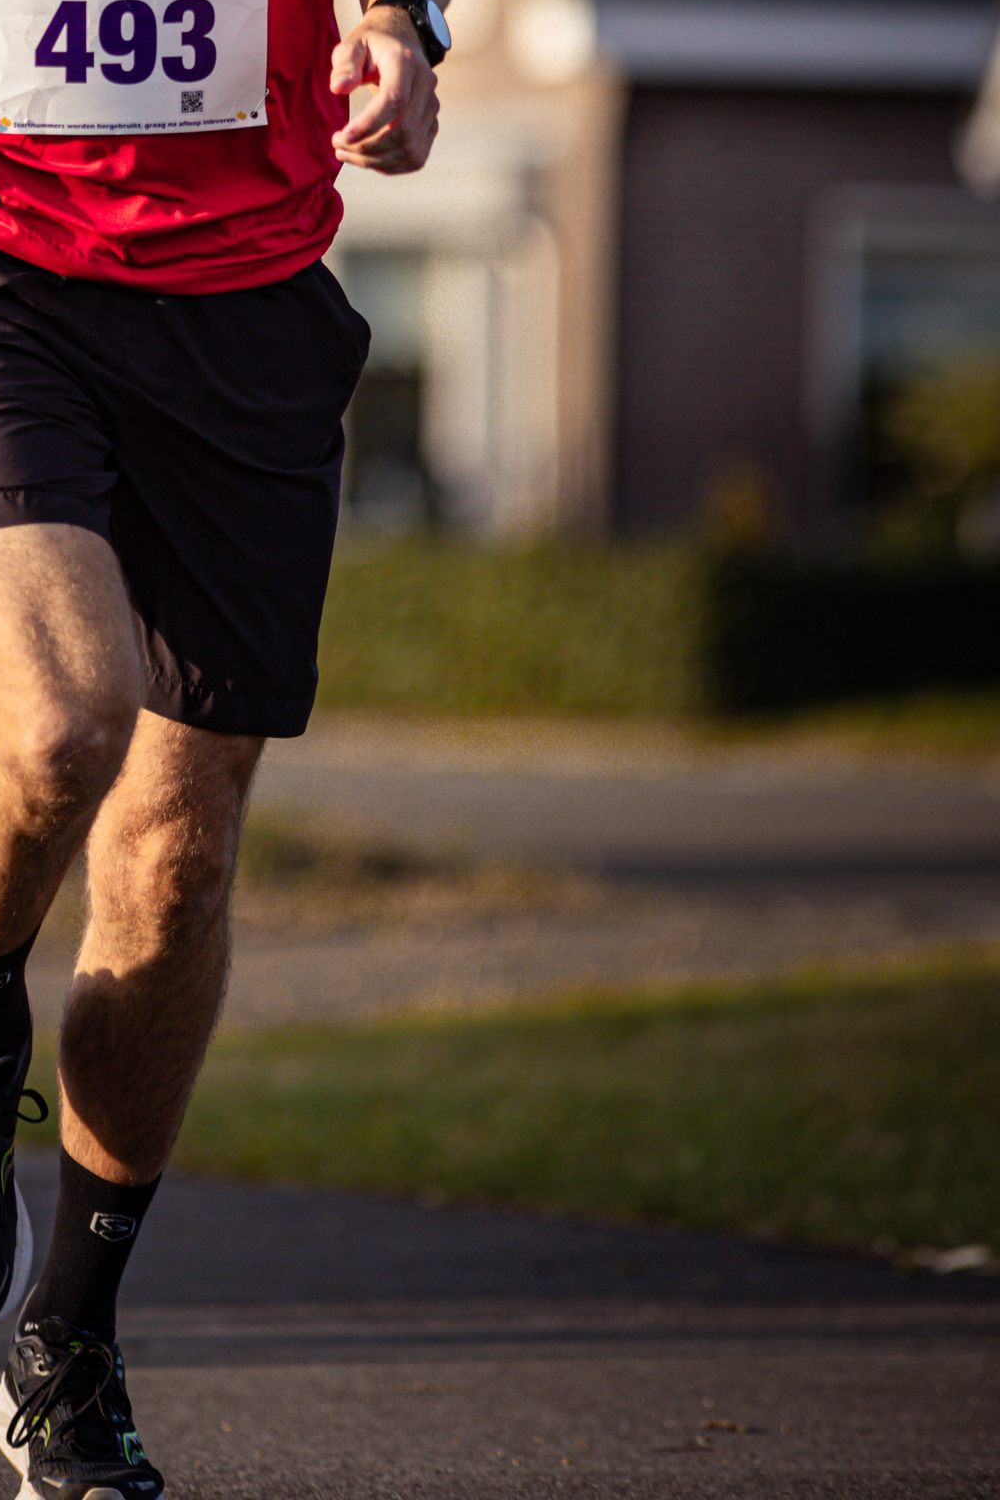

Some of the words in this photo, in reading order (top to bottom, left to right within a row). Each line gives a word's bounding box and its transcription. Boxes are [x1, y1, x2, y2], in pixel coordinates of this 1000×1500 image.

[66, 122, 95, 130] worden
[97, 121, 142, 131] hergebruikt,
[144, 122, 166, 130] graag
[179, 119, 202, 128] afloop
[203, 117, 237, 125] inleveren.
